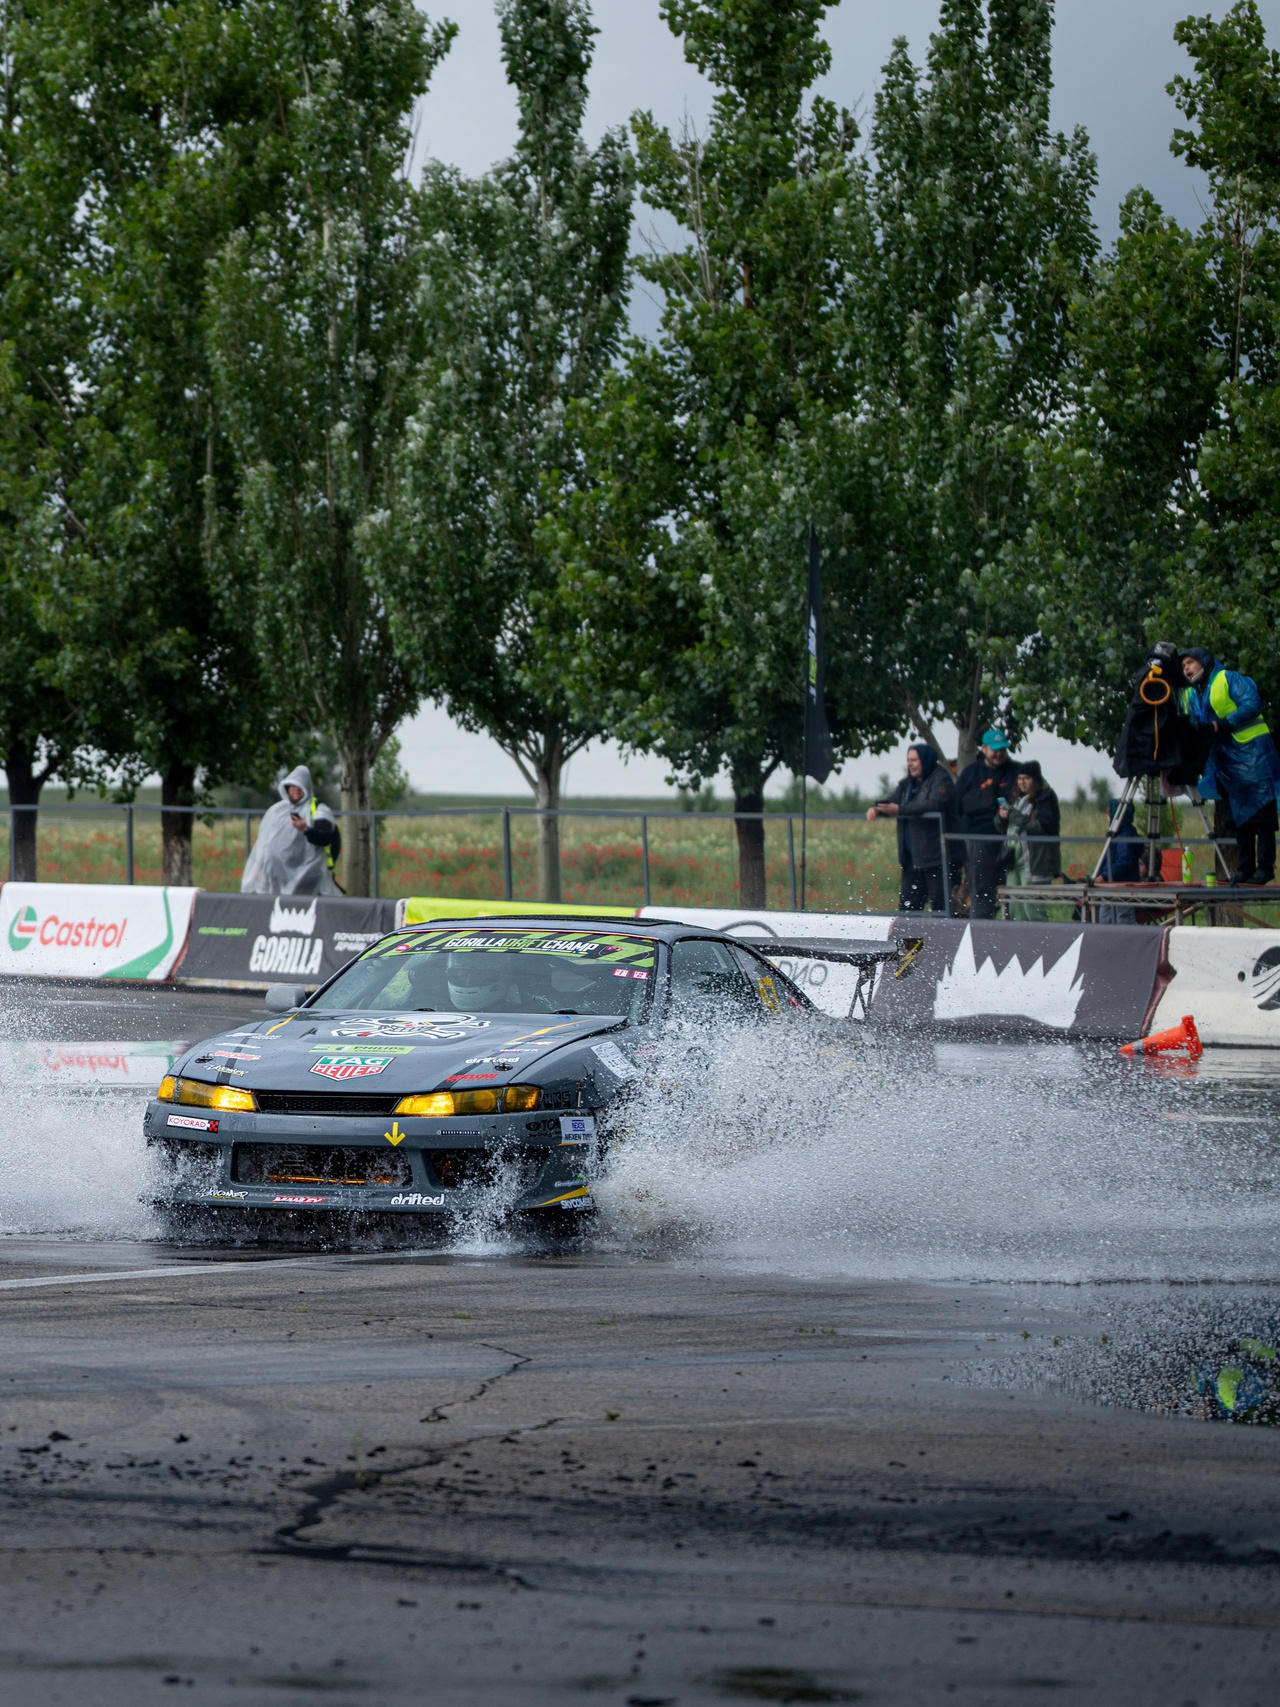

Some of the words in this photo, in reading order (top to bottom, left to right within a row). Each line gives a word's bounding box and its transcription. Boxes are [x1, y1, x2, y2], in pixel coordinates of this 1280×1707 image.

[39, 915, 128, 949] Castrol
[250, 935, 324, 975] GORILLA
[326, 1057, 386, 1065] TAG
[314, 1065, 381, 1079] HEUER
[168, 1117, 207, 1128] KOYORAD
[390, 1193, 445, 1206] drifted
